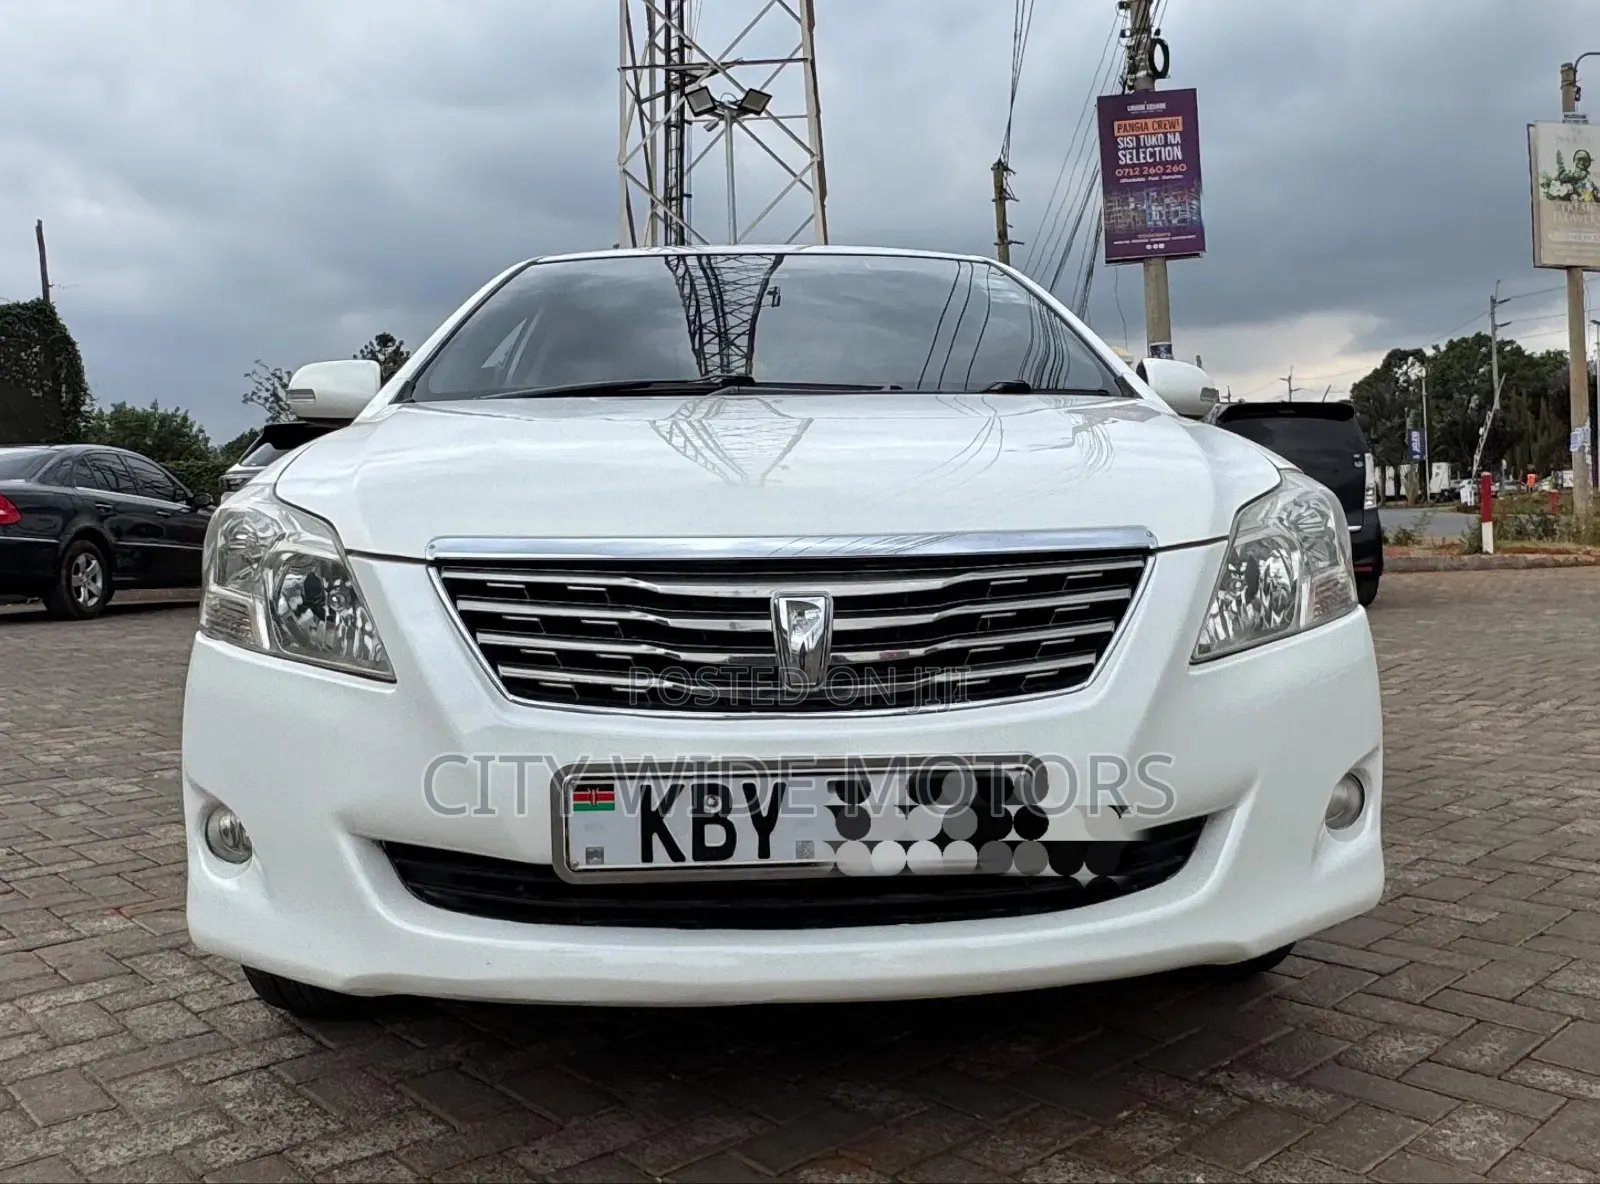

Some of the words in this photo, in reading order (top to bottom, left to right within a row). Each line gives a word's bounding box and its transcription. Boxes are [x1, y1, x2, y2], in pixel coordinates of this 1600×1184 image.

[1117, 121, 1149, 134] PANGIA
[1152, 118, 1180, 131] CREW!
[1116, 136, 1136, 149] SISI
[1139, 133, 1165, 147] TUKO
[1167, 131, 1182, 145] NA
[1117, 145, 1183, 165] SELECTION
[1115, 167, 1140, 177] 0712
[1142, 165, 1164, 175] 260
[1165, 163, 1187, 173] 260
[640, 781, 787, 863] KBY
